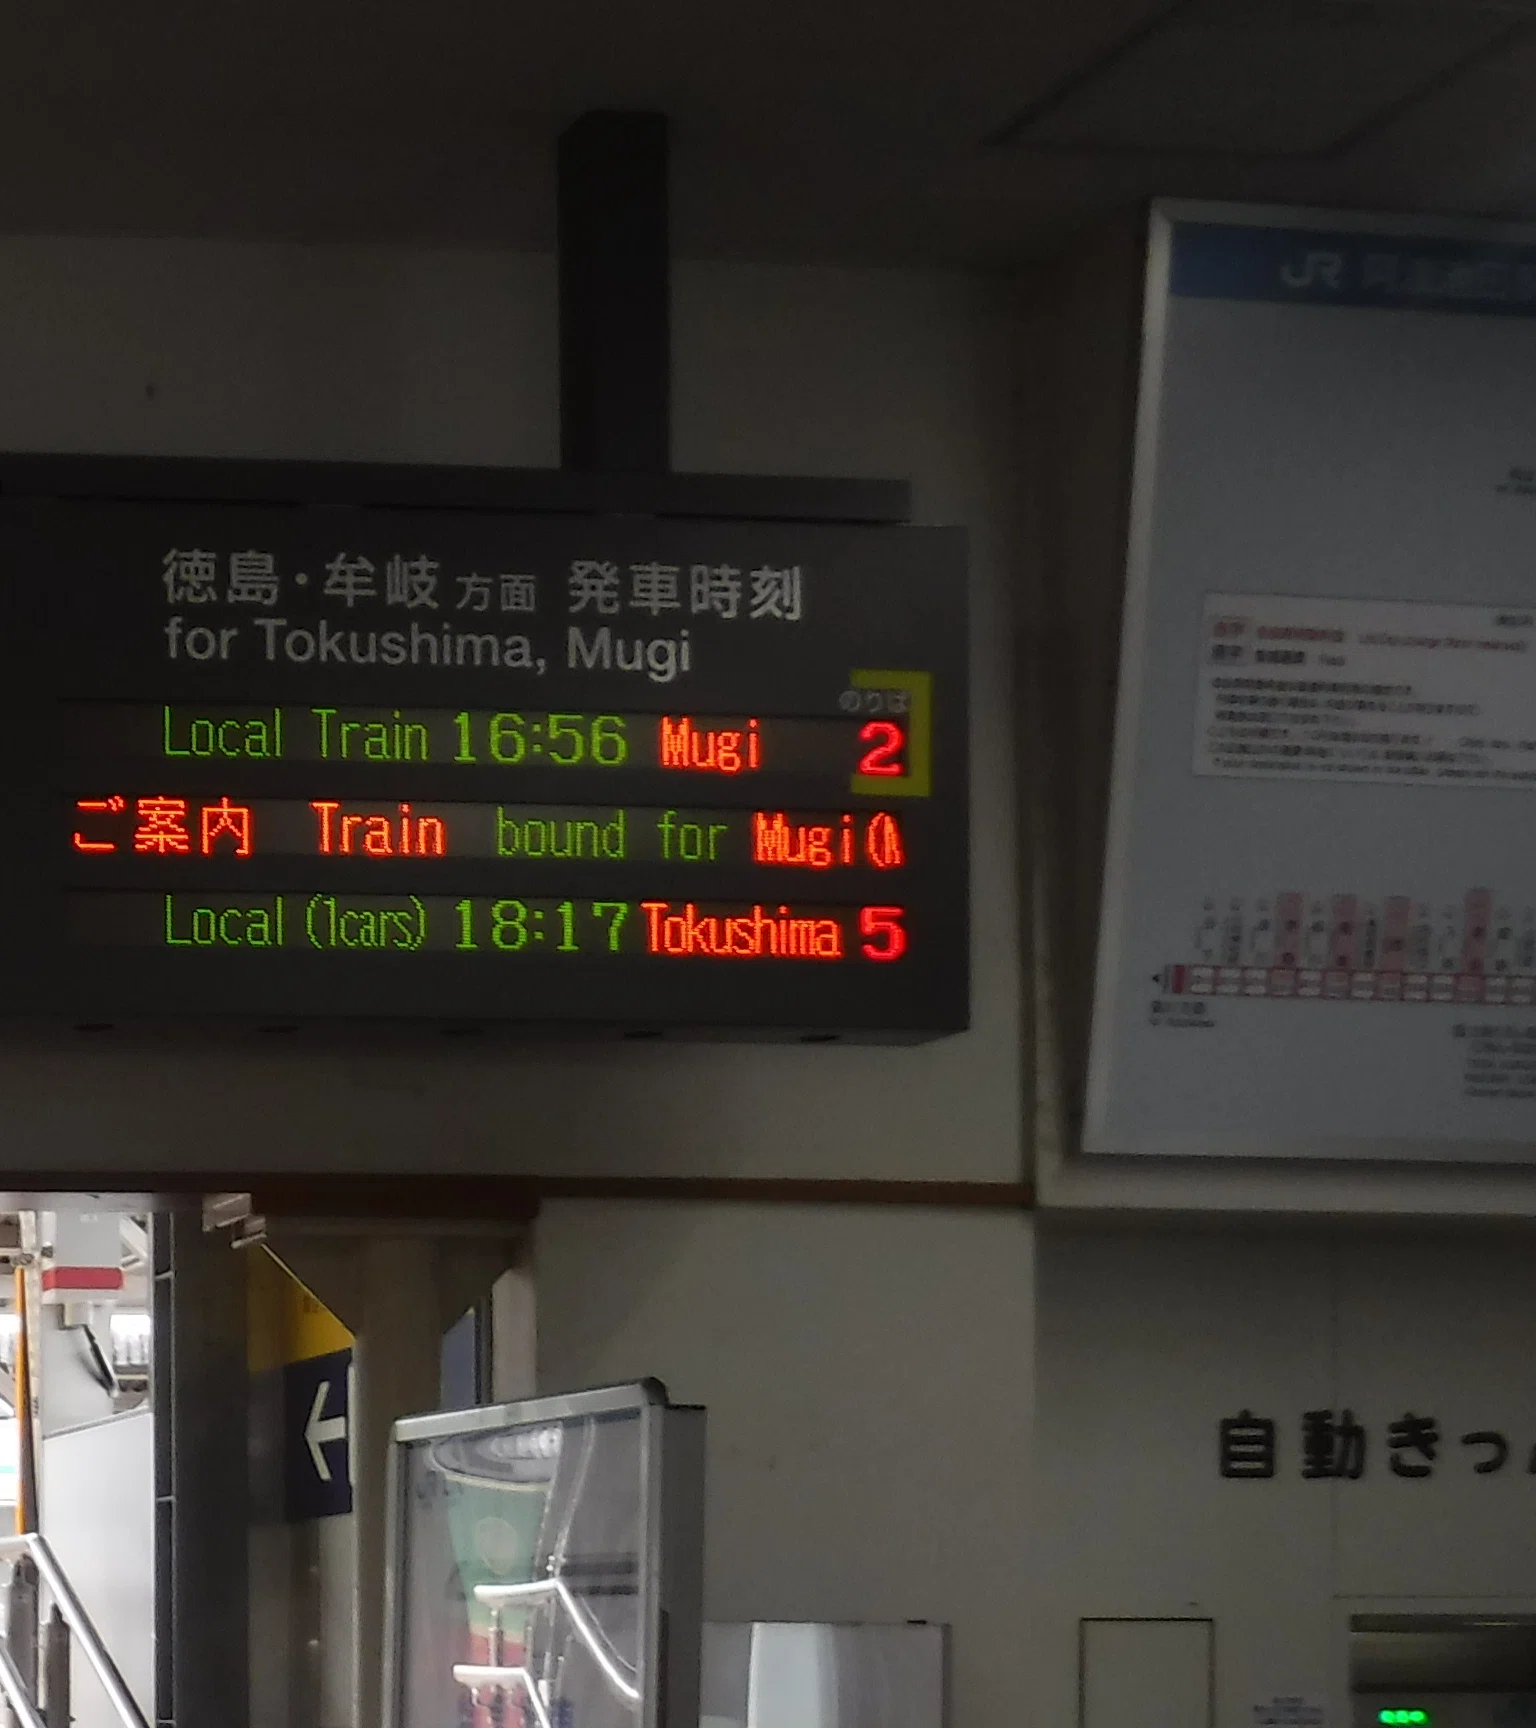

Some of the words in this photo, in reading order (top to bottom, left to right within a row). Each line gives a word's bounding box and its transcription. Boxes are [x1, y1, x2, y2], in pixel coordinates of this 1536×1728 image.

[161, 548, 442, 610] 徳島・牟岐
[456, 570, 539, 614] 方面
[567, 562, 805, 622] 発車時刻
[164, 616, 235, 660] for
[262, 617, 548, 675] Tokushima,
[567, 629, 693, 683] Mugi
[162, 702, 285, 758] Local
[310, 706, 429, 762] Train
[452, 710, 628, 767] 16:56
[659, 714, 762, 774] Mugi
[857, 719, 907, 777] 2
[71, 795, 255, 857] ご案内
[308, 799, 447, 858] Train
[496, 805, 626, 860] bound
[655, 808, 729, 863] for
[164, 893, 285, 948] Local
[454, 897, 630, 954] 18:17
[639, 900, 845, 959] Tokushima
[857, 904, 908, 962] 5
[1220, 1409, 1536, 1480] 自動きっ
